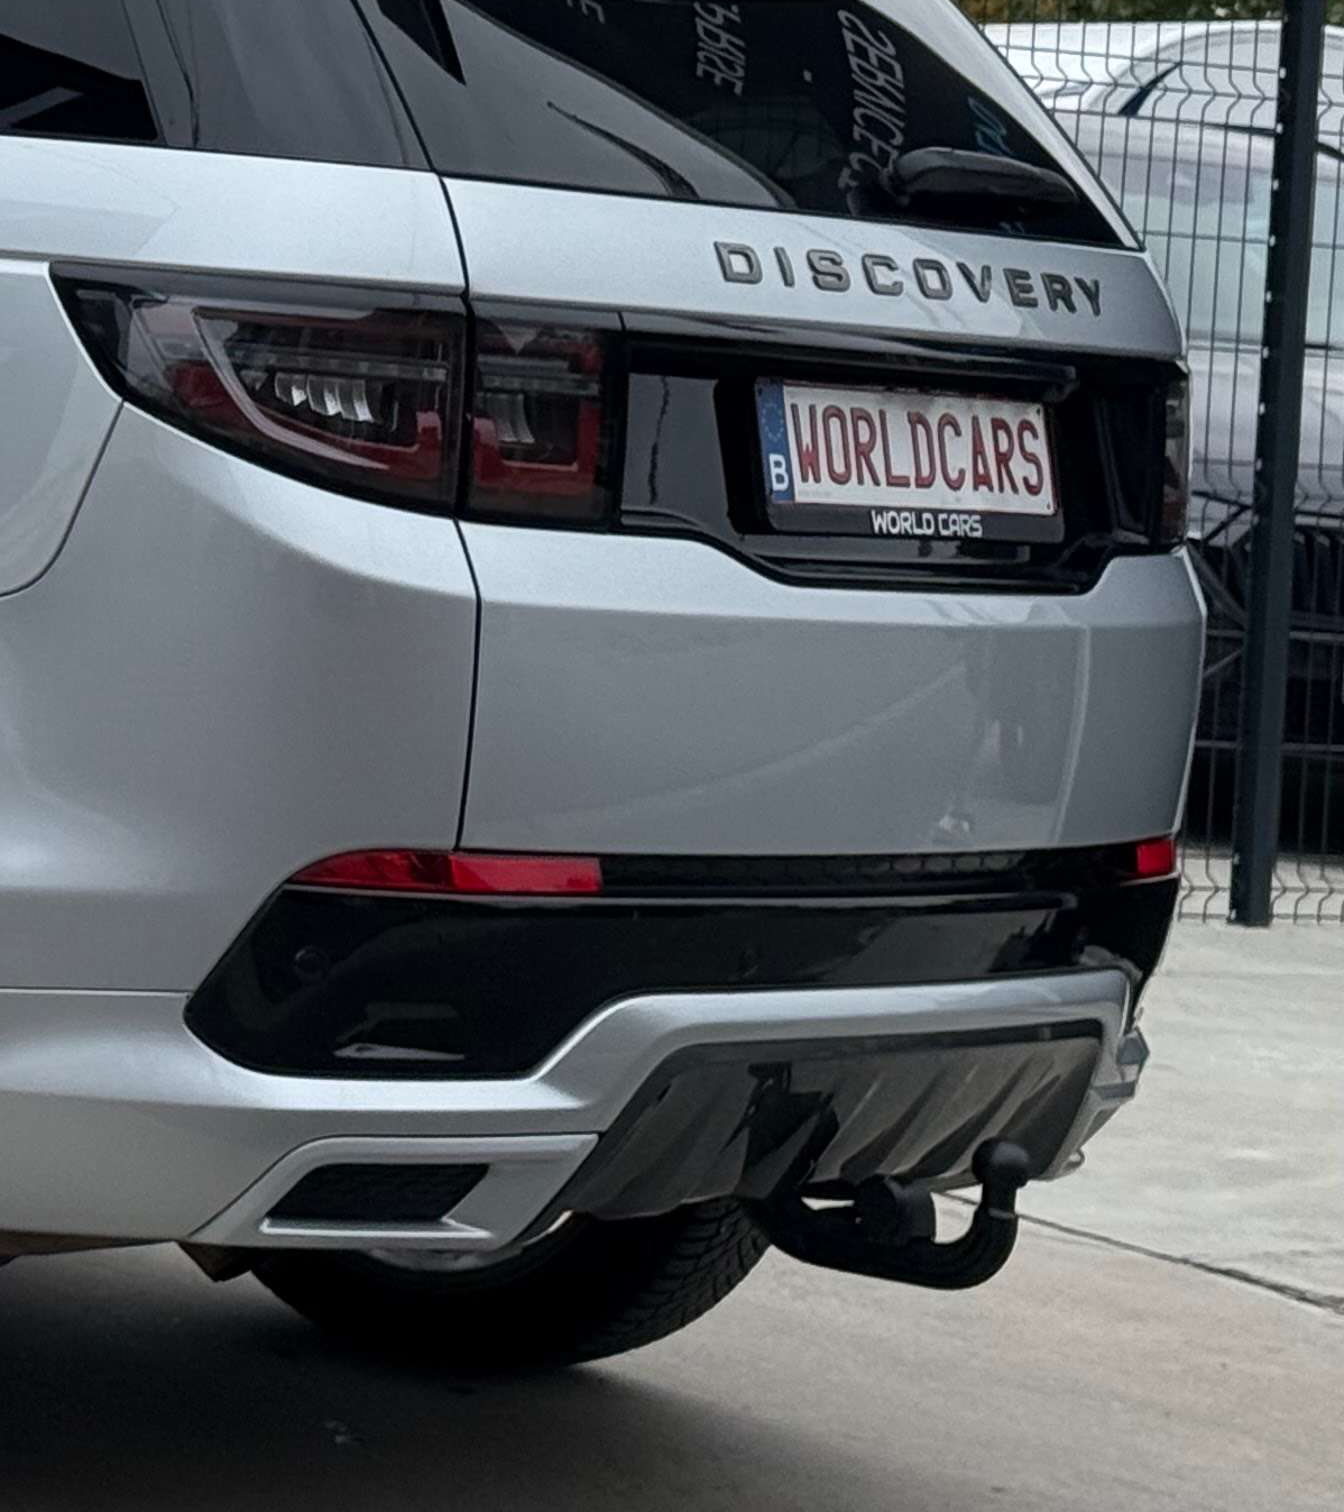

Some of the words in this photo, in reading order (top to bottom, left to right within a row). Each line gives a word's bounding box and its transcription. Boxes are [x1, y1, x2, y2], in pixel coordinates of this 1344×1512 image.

[713, 240, 1103, 318] DISCOVERY
[769, 454, 790, 492] B
[791, 403, 1045, 496] WORLDCARS
[871, 509, 936, 536] WORLD
[938, 512, 983, 538] CARS
